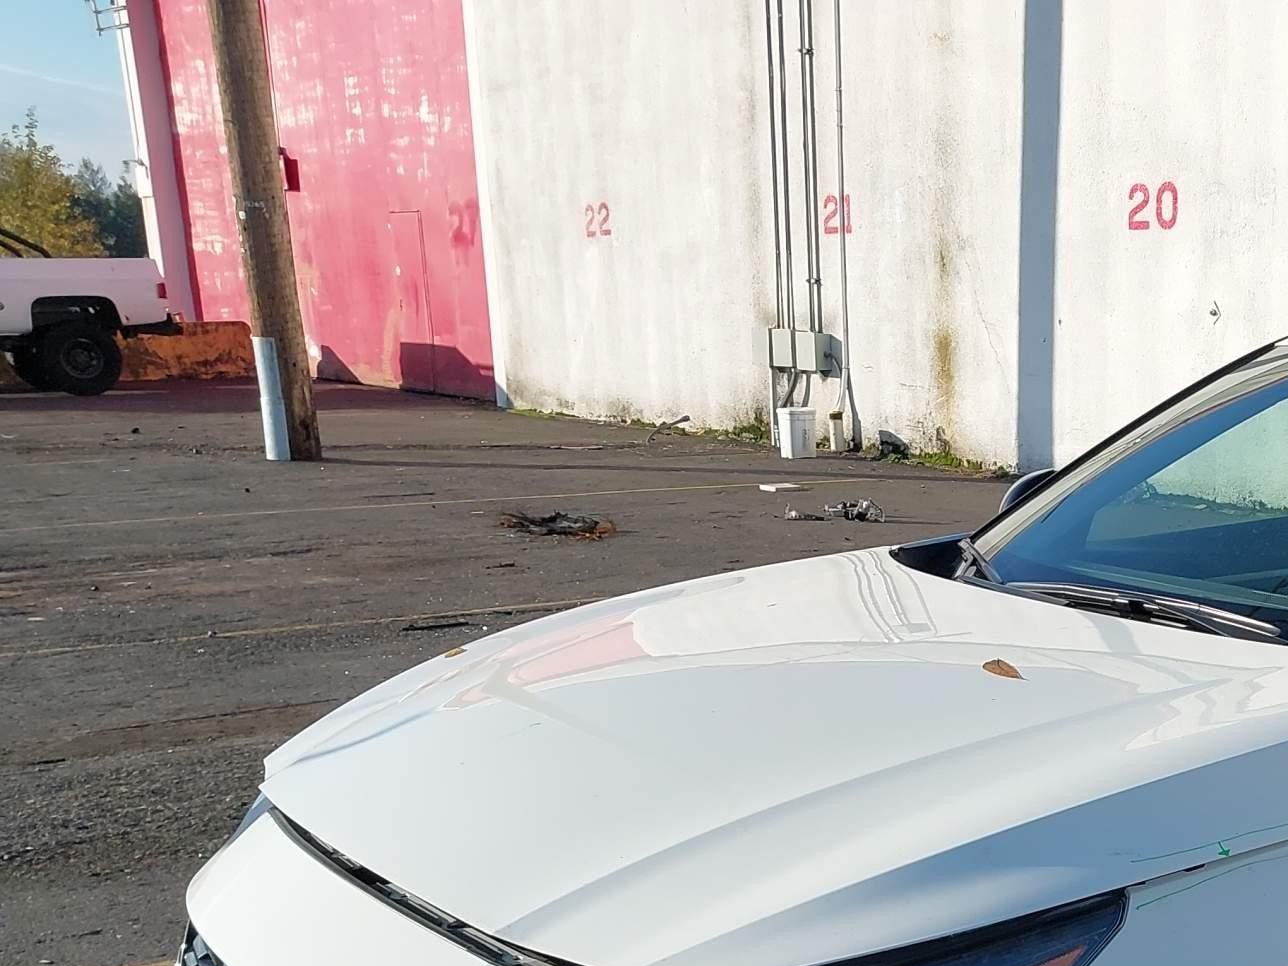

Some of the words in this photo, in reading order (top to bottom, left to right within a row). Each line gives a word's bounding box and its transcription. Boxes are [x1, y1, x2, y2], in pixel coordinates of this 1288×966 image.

[585, 202, 611, 237] 22
[823, 194, 852, 234] 21
[1128, 181, 1178, 230] 20
